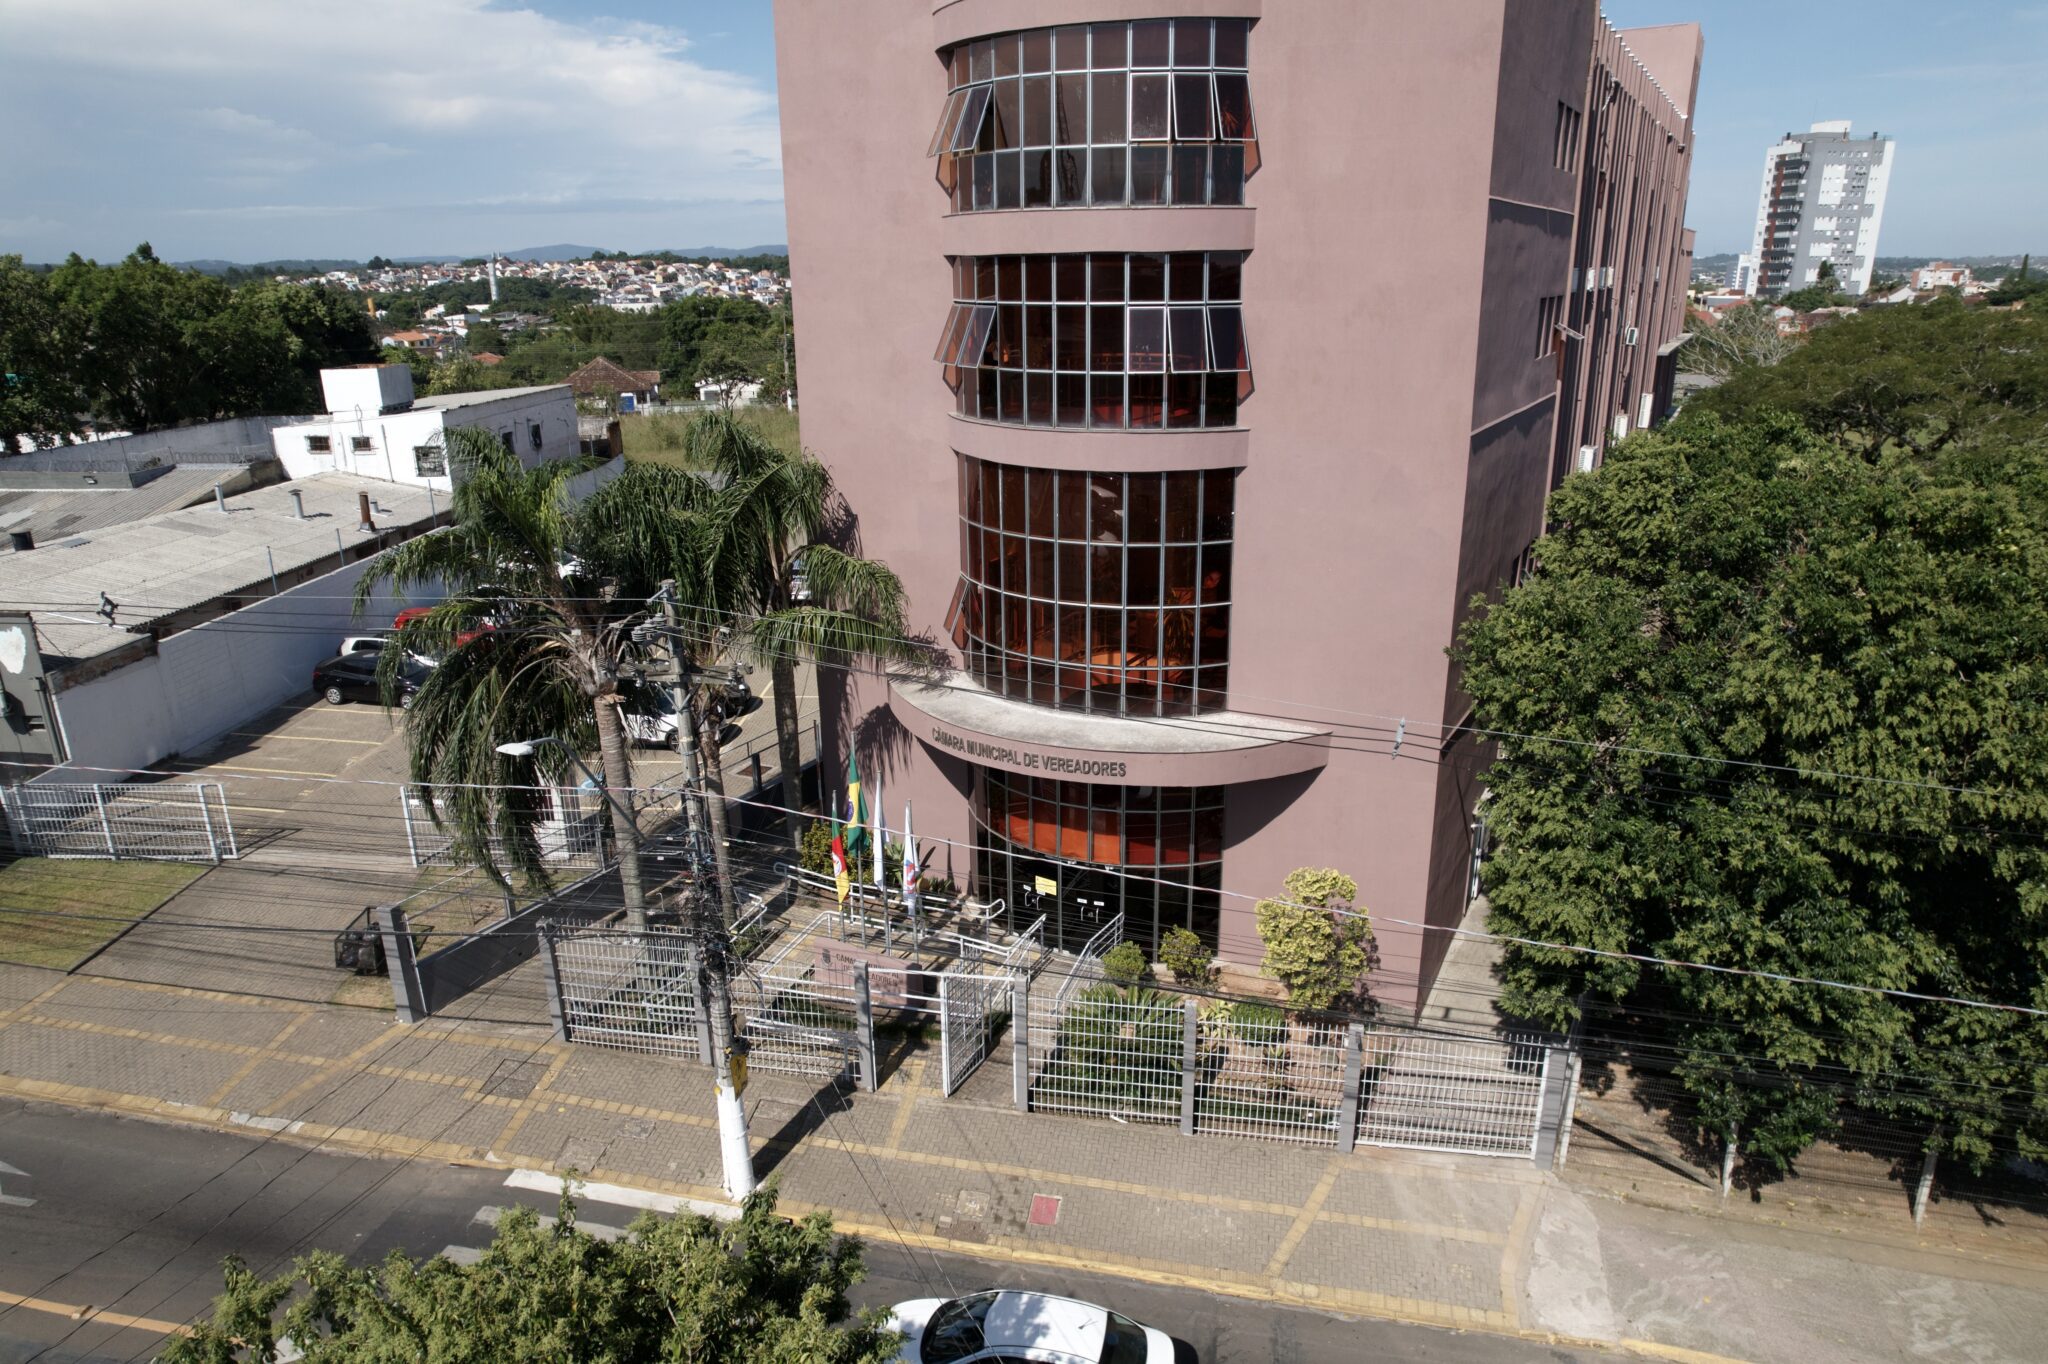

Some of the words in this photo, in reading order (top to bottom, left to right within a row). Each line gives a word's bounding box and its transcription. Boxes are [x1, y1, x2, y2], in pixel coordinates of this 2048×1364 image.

[932, 727, 966, 753] CÂMARA
[967, 739, 1021, 765] MUNICIPAL
[1023, 752, 1039, 769] DE
[1041, 755, 1127, 777] VEREADORES
